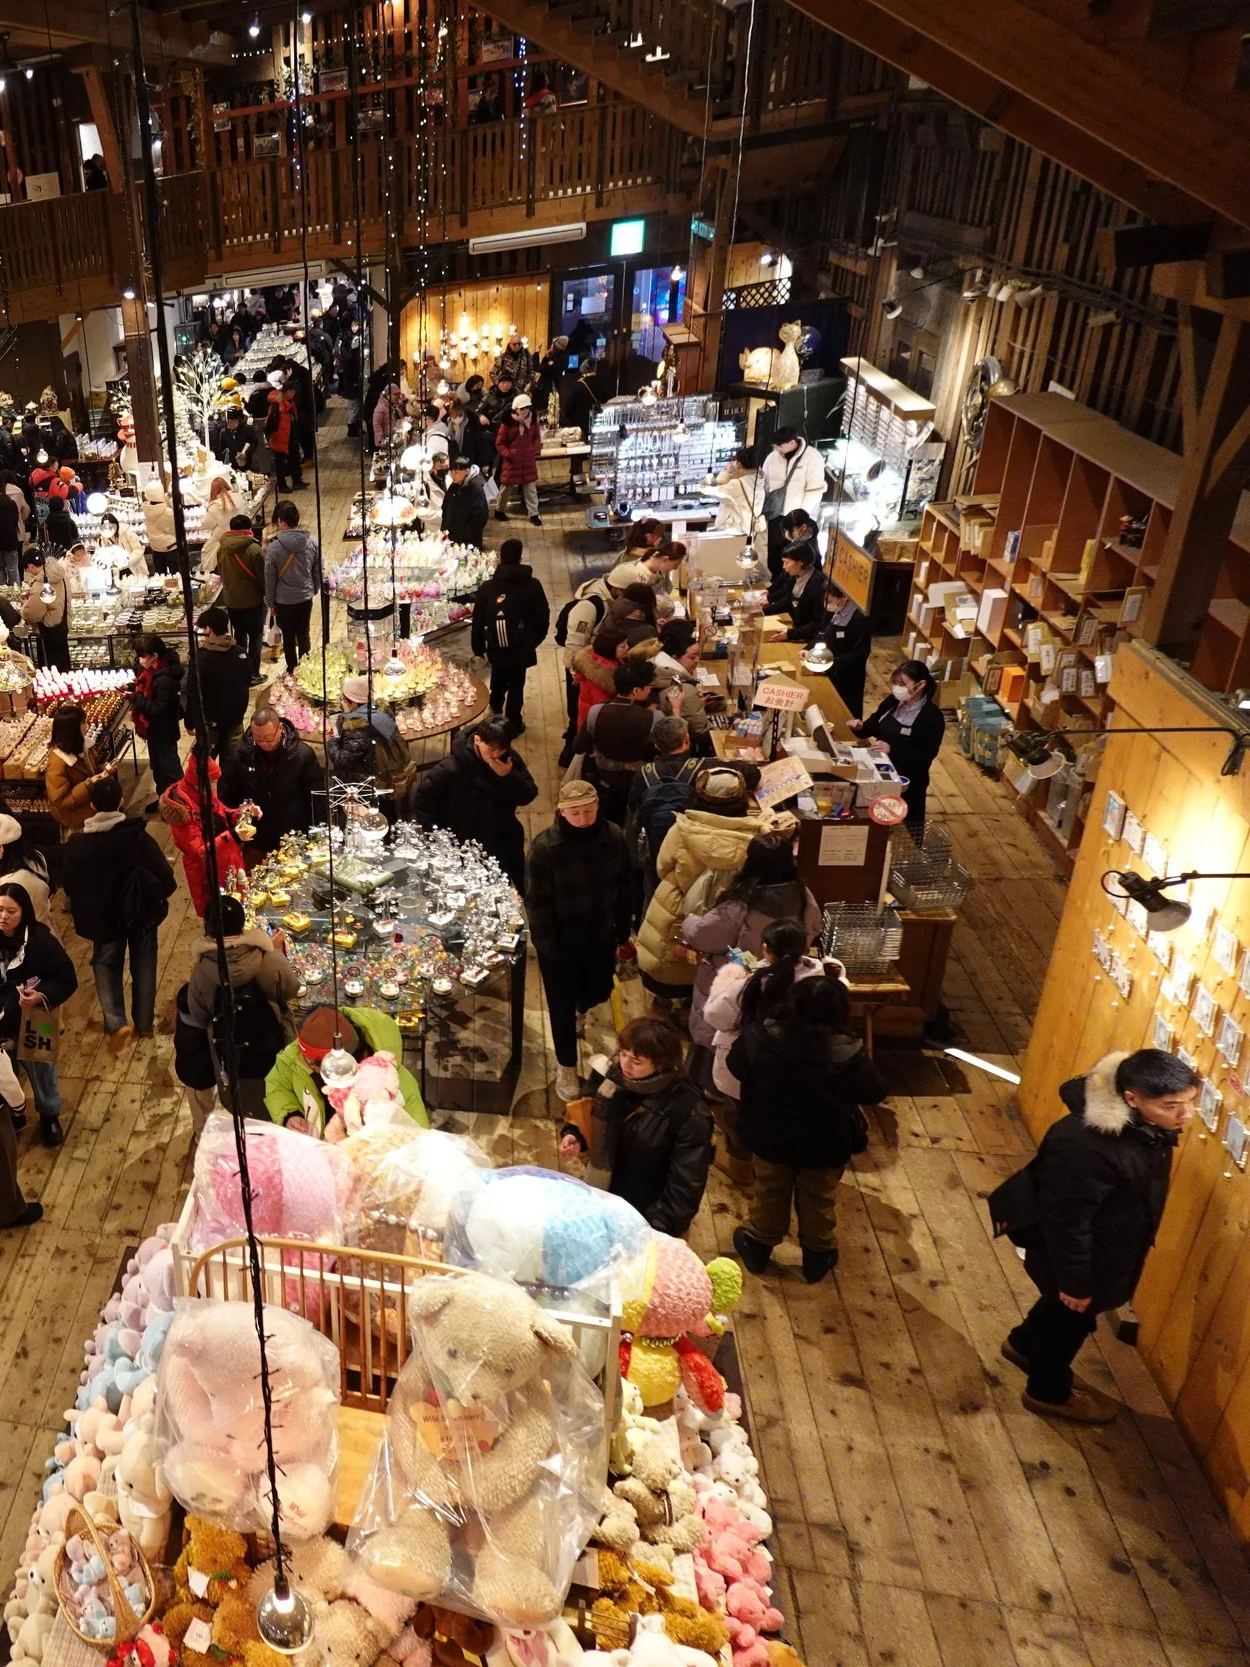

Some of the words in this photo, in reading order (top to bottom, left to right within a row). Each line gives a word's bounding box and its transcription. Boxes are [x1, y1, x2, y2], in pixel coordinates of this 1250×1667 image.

[762, 687, 804, 700] CASHIER
[764, 697, 795, 708] お会計
[422, 1414, 439, 1423] Wild
